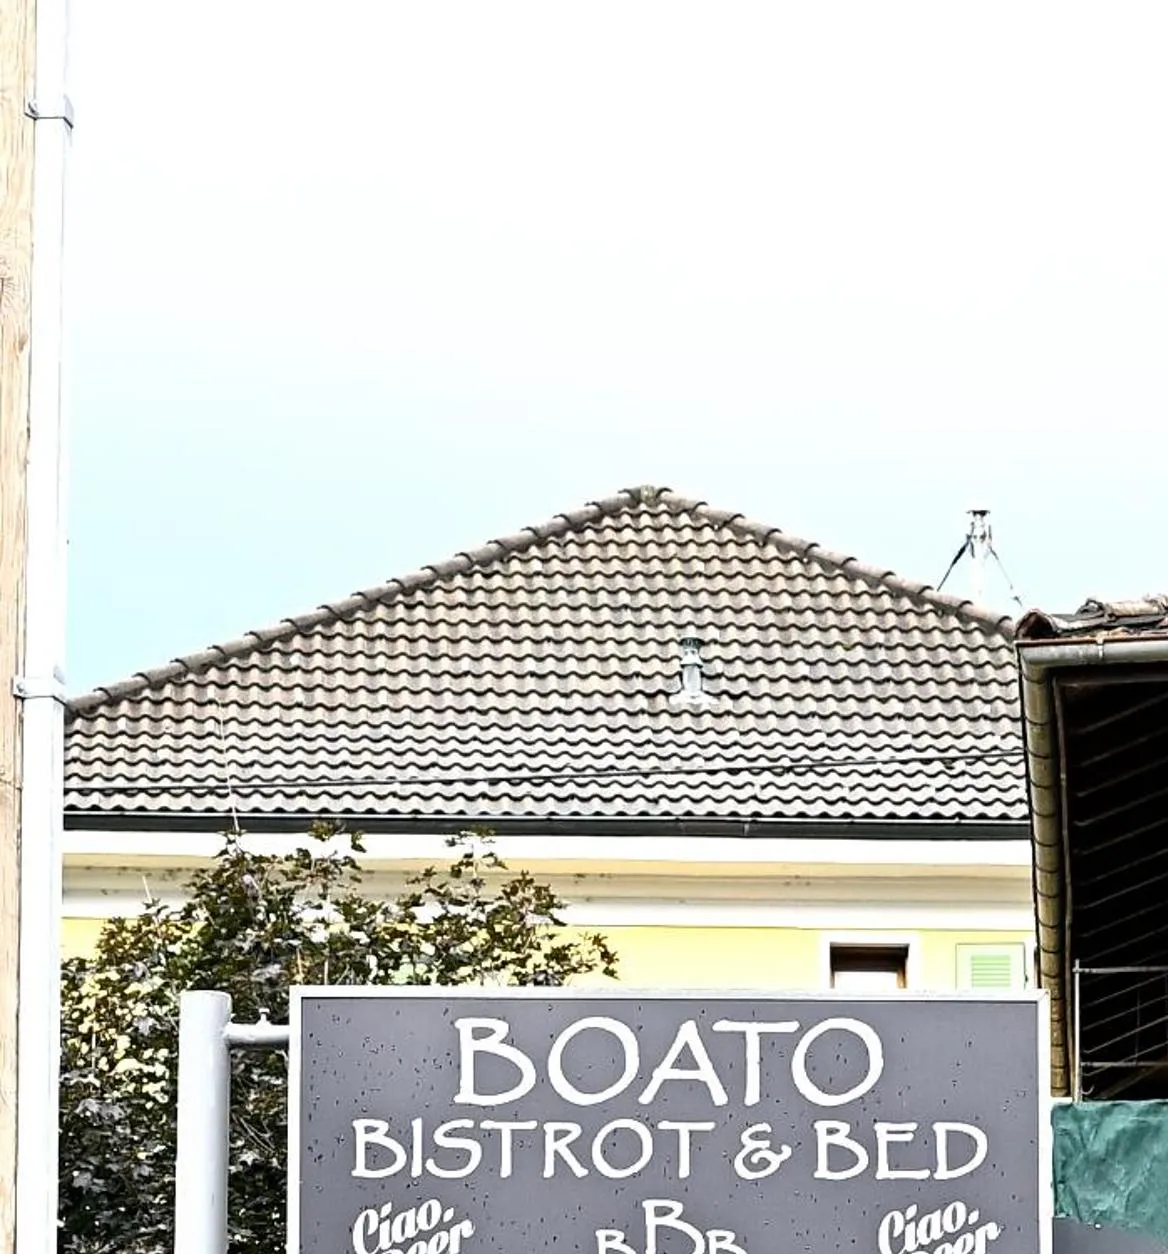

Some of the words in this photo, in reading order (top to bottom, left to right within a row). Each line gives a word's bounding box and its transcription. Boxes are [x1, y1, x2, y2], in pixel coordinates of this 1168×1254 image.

[454, 1017, 883, 1106] BOATO
[352, 1118, 715, 1179] BISTROT
[734, 1122, 792, 1180] &
[814, 1121, 988, 1180] BED
